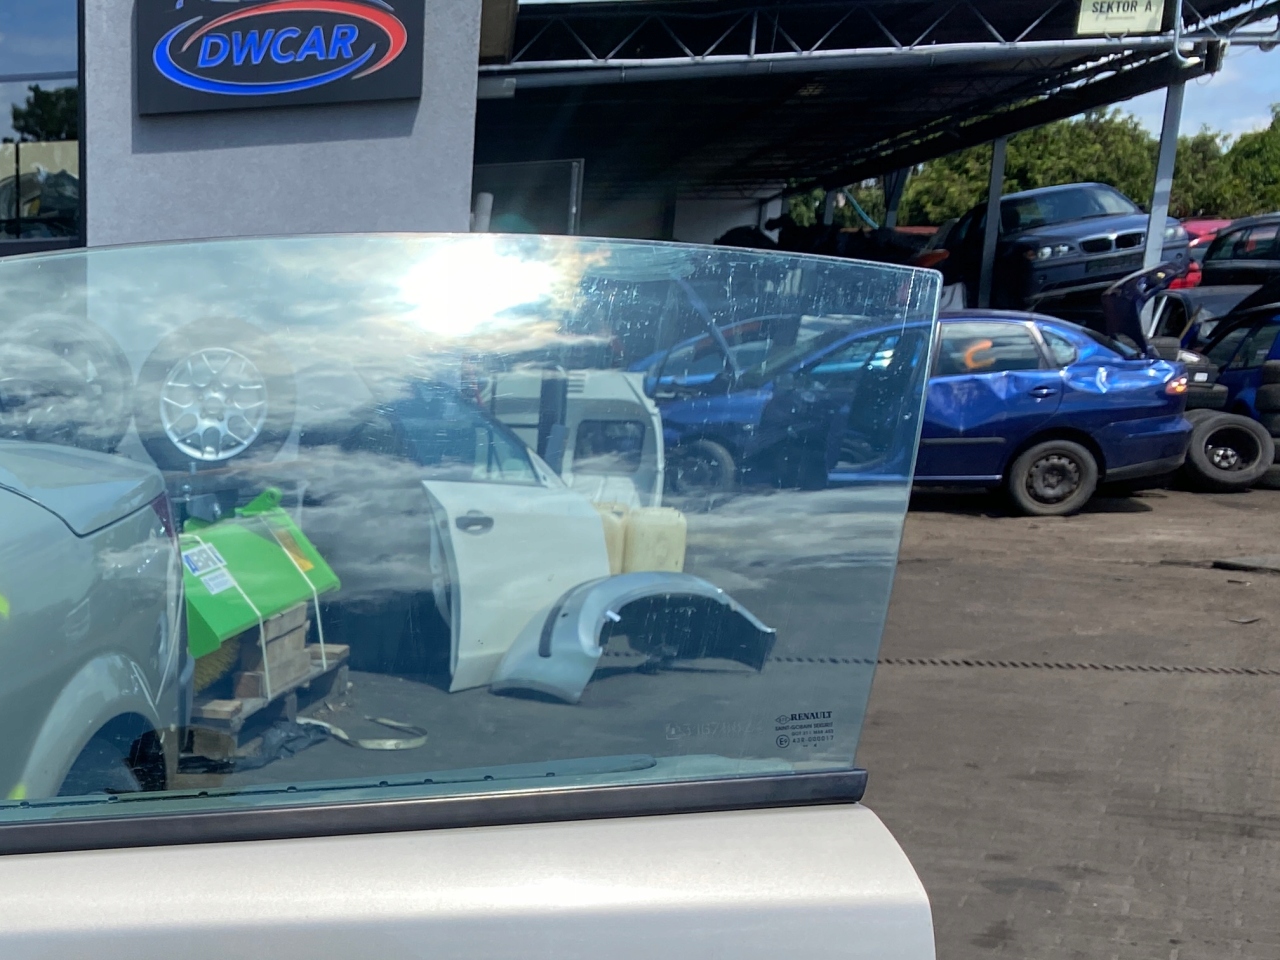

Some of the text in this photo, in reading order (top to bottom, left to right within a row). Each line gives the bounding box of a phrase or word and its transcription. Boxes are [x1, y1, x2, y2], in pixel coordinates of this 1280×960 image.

[1092, 0, 1152, 13] SEKTOR A
[196, 24, 359, 68] DWCAR
[790, 711, 833, 721] RENAULT
